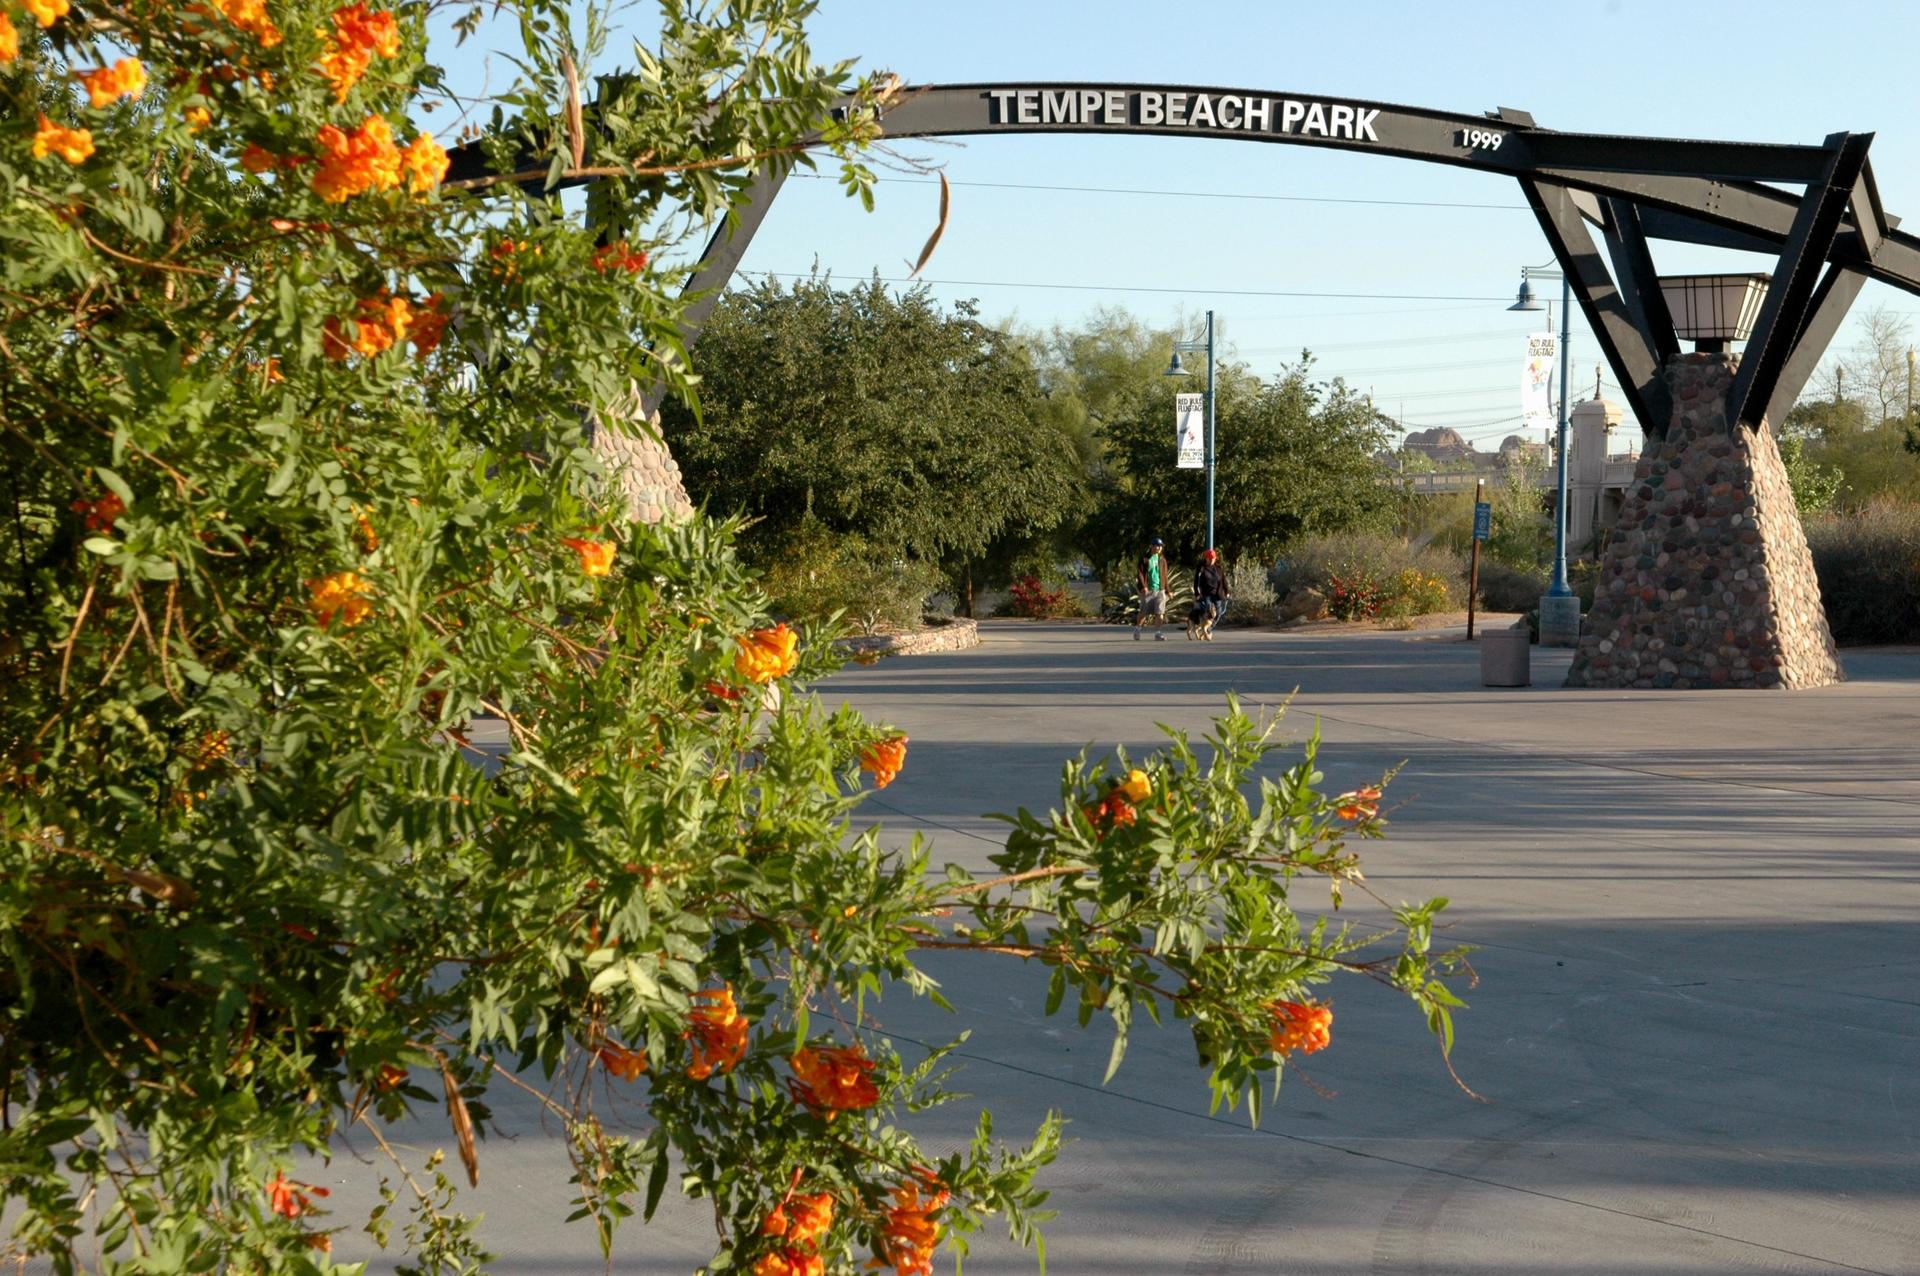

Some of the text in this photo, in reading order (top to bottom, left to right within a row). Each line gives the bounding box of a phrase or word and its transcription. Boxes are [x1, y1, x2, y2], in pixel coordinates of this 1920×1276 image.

[990, 90, 1381, 142] TEMPE BEACH PARK
[1463, 128, 1503, 151] 1999
